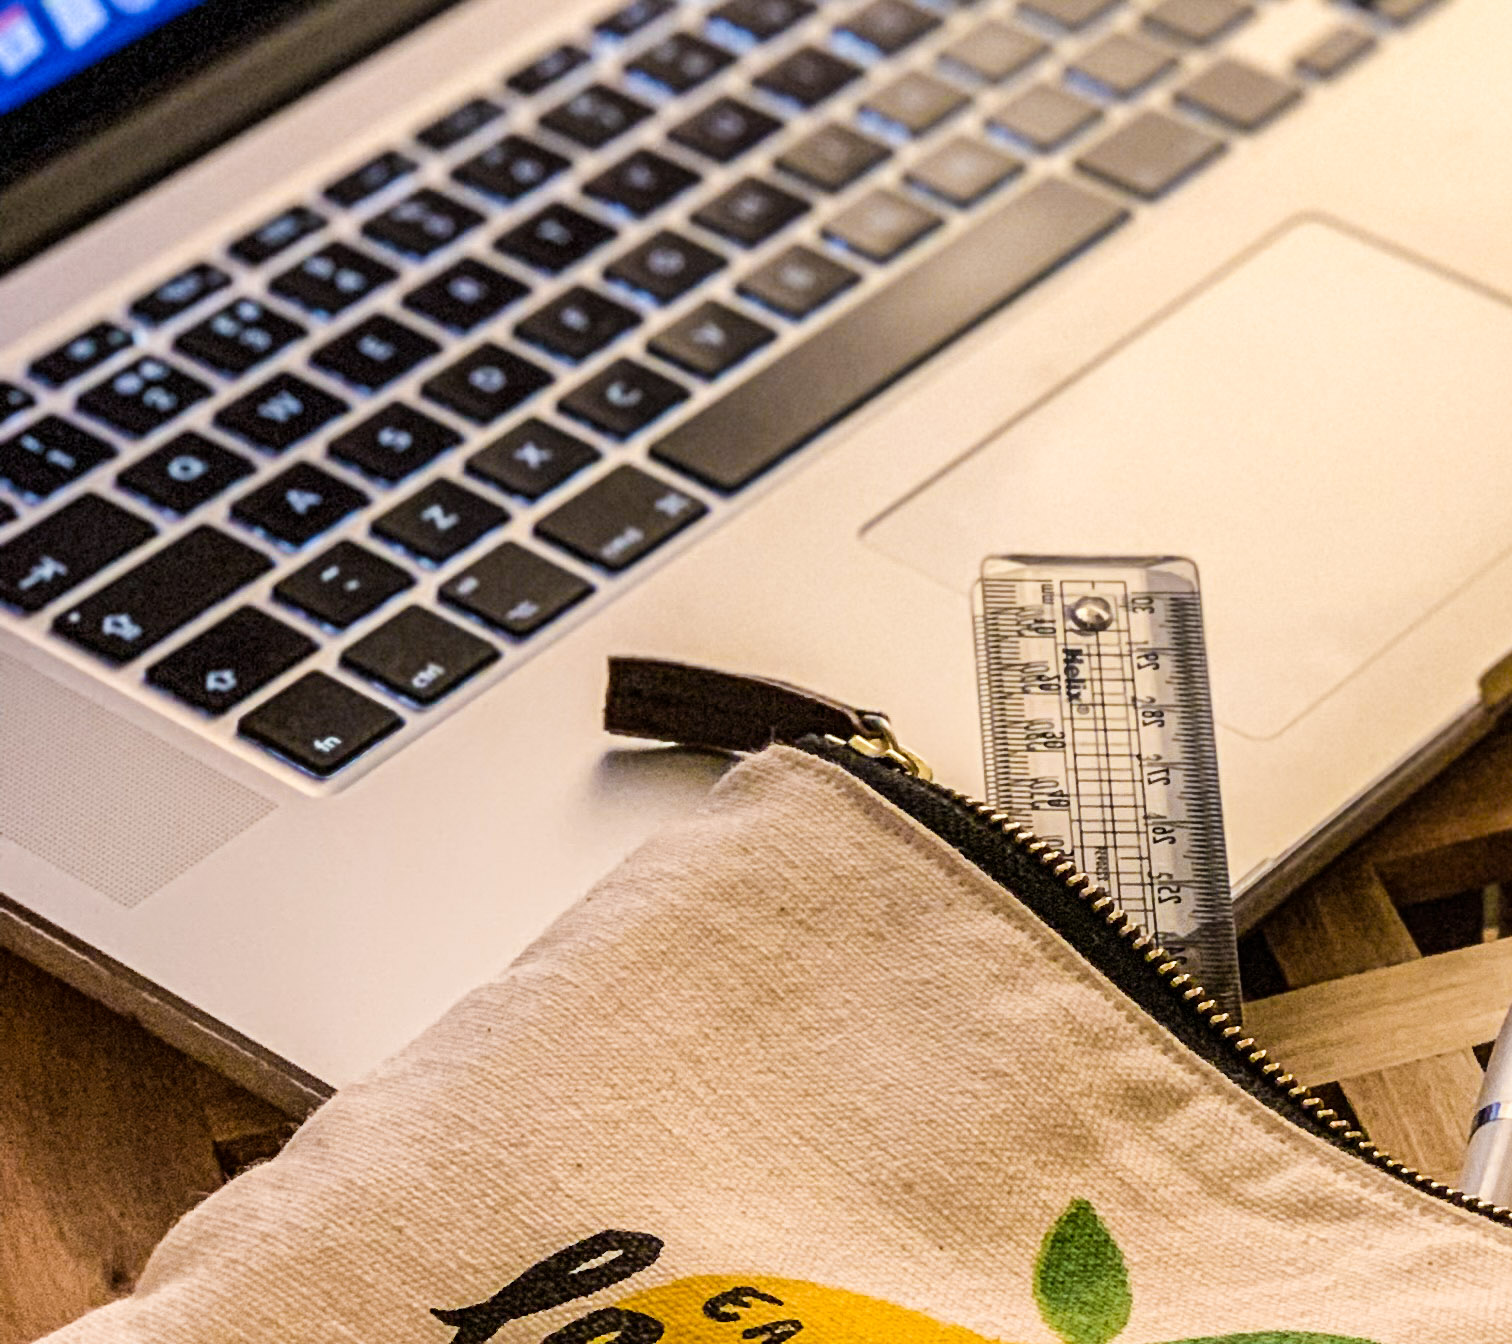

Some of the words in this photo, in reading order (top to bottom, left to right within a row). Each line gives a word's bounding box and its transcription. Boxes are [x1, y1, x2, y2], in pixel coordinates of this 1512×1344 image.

[284, 488, 322, 515] A
[420, 504, 460, 531] Z
[1062, 648, 1087, 703] Helix
[313, 735, 343, 753] fn
